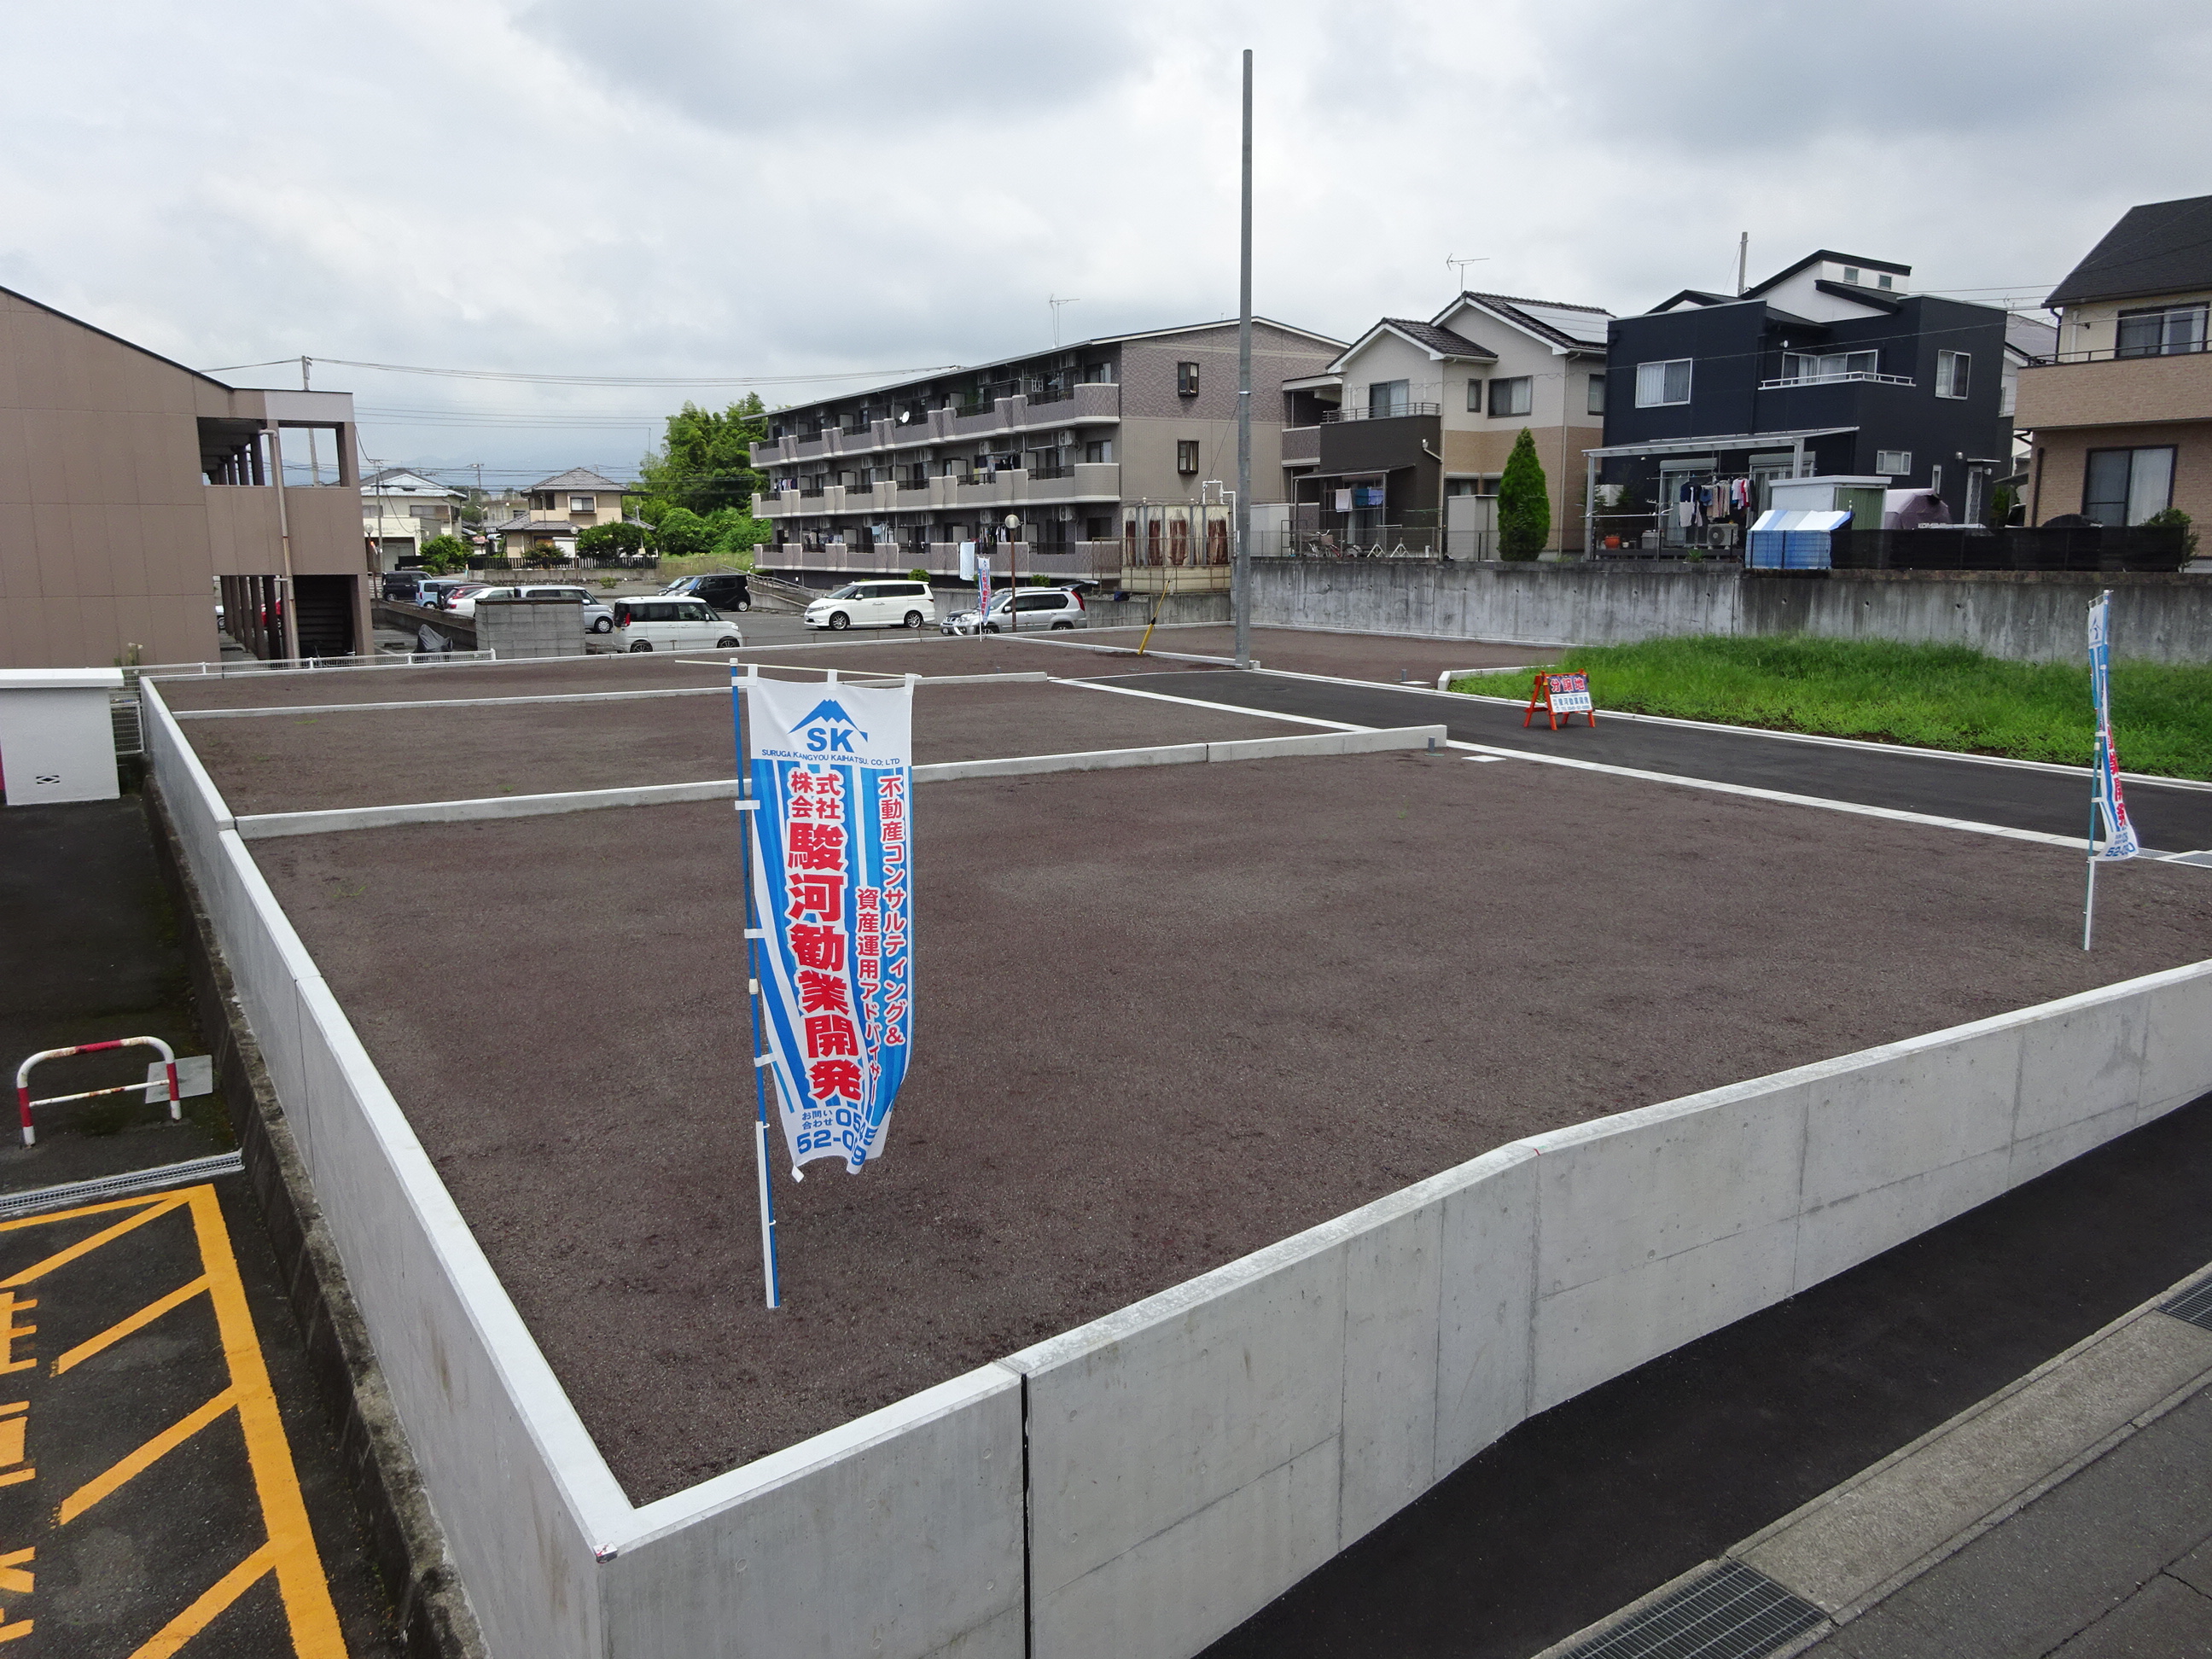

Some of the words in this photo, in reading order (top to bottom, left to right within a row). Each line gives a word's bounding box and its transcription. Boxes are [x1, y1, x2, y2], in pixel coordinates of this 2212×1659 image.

[806, 727, 855, 753] SK
[761, 748, 791, 758] SURUGA
[793, 751, 829, 761] KANGYOU
[880, 776, 905, 1045] 不動産コンサルティング&
[788, 822, 862, 1101] 駿河勧業開発
[802, 1110, 833, 1121] お問い
[802, 1118, 833, 1131] 合わせ
